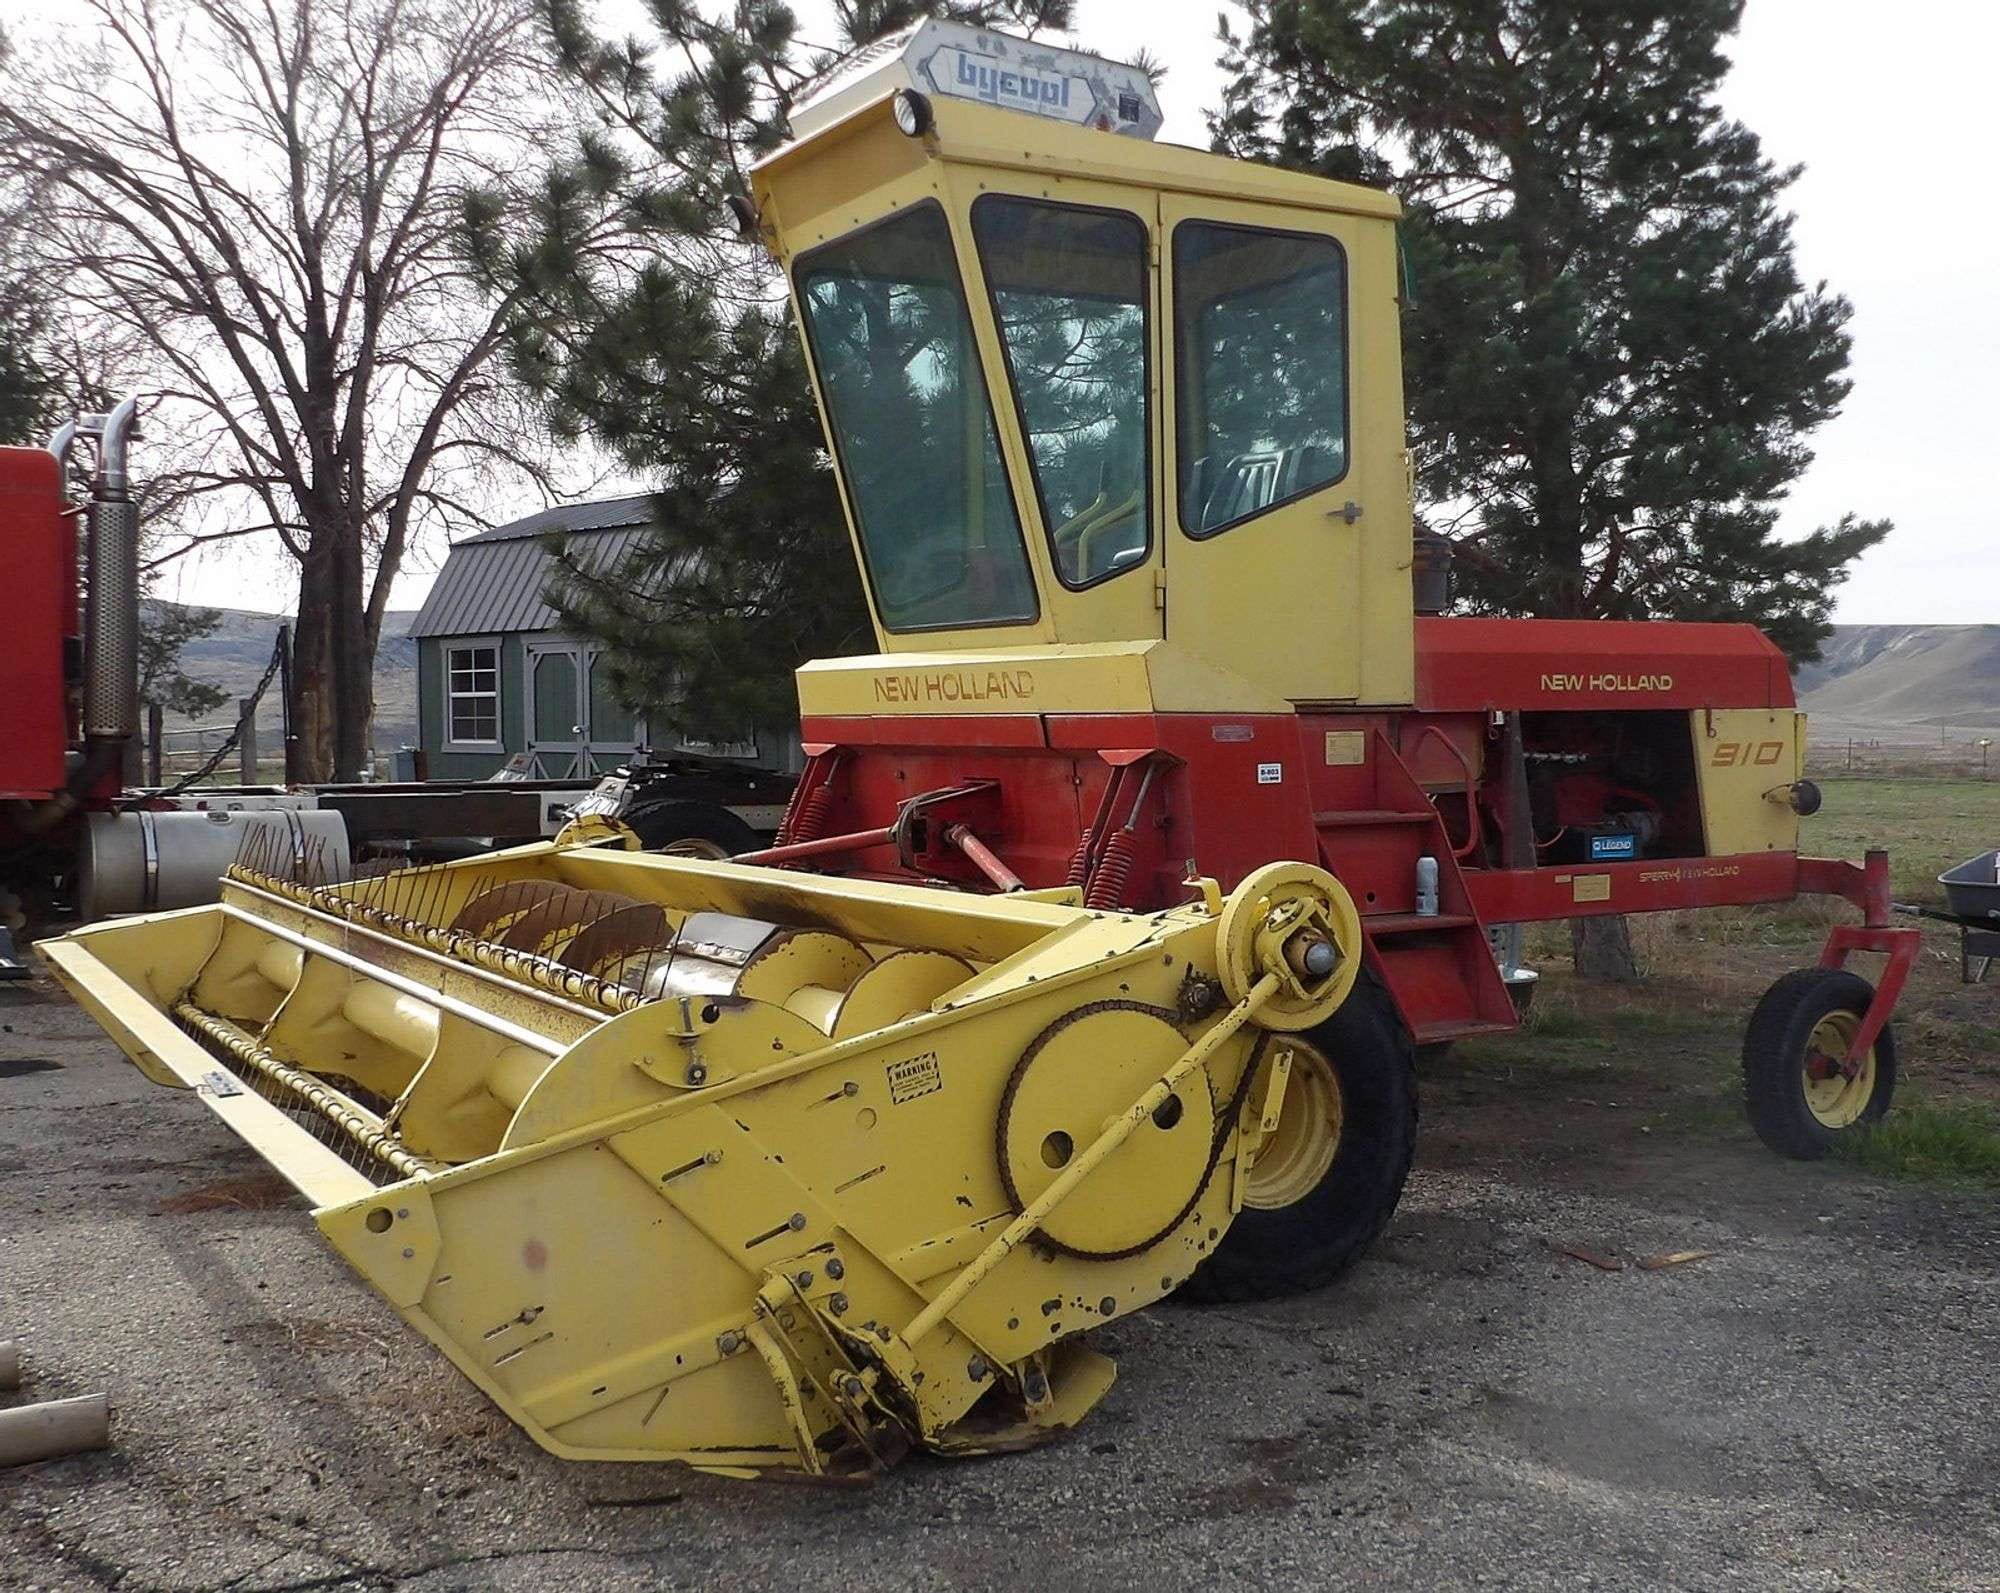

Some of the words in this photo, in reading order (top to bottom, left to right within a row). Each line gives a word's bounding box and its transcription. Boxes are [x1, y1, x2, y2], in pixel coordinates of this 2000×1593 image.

[873, 676, 918, 702] NEW
[925, 670, 1034, 701] HOLLAND
[1541, 674, 1583, 691] NEW
[1589, 674, 1673, 692] HOLLAND
[1711, 742, 1784, 767] 910
[1602, 840, 1631, 850] LEGEND
[895, 1061, 932, 1081] WARNING
